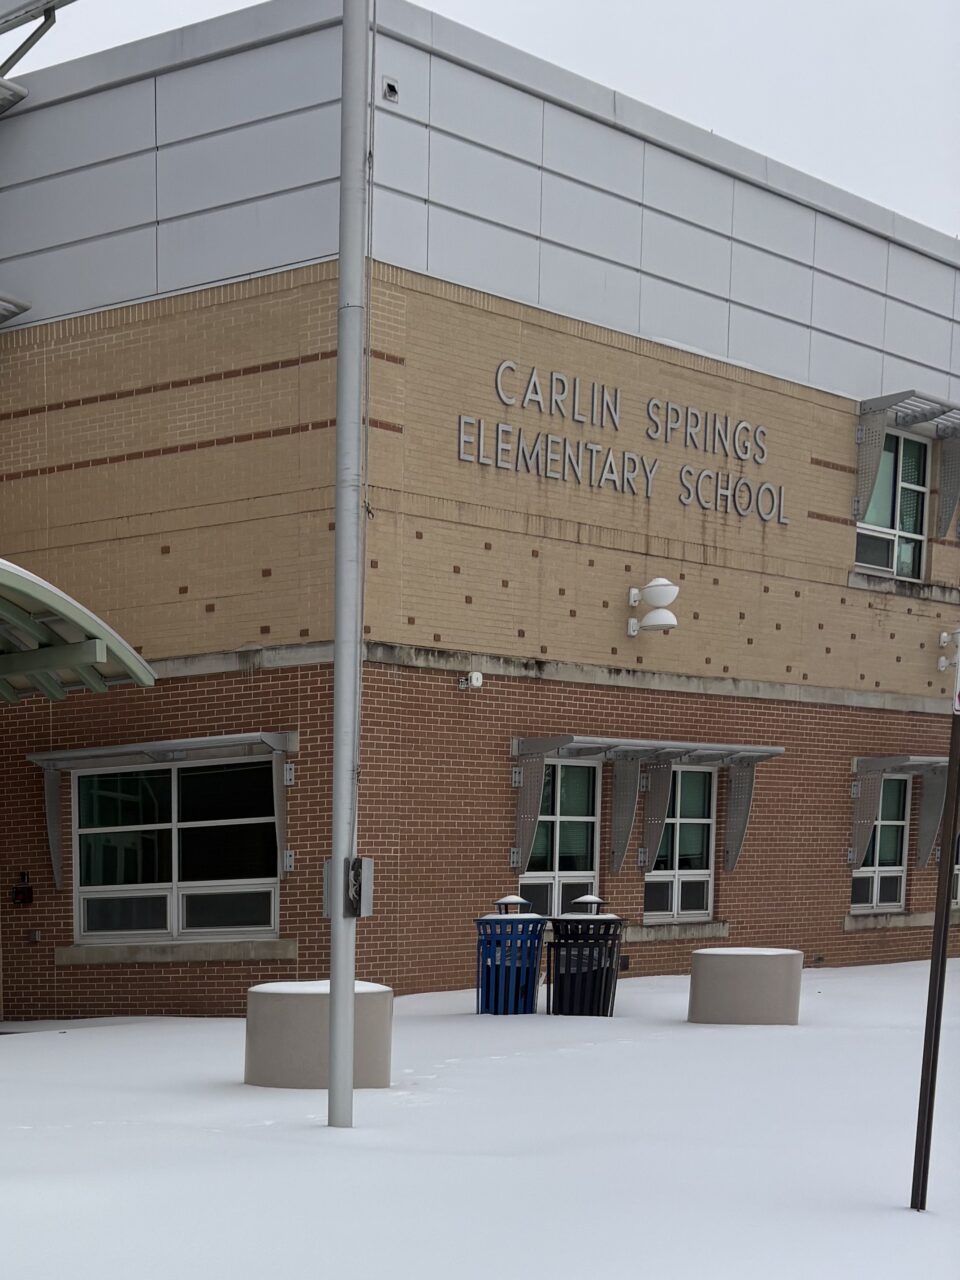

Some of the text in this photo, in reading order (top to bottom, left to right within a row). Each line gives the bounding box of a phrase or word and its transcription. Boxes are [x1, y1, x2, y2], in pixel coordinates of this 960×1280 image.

[495, 359, 768, 465] CARLIN SPRINGS
[458, 414, 791, 525] ELEMENTARY SCHOOL
